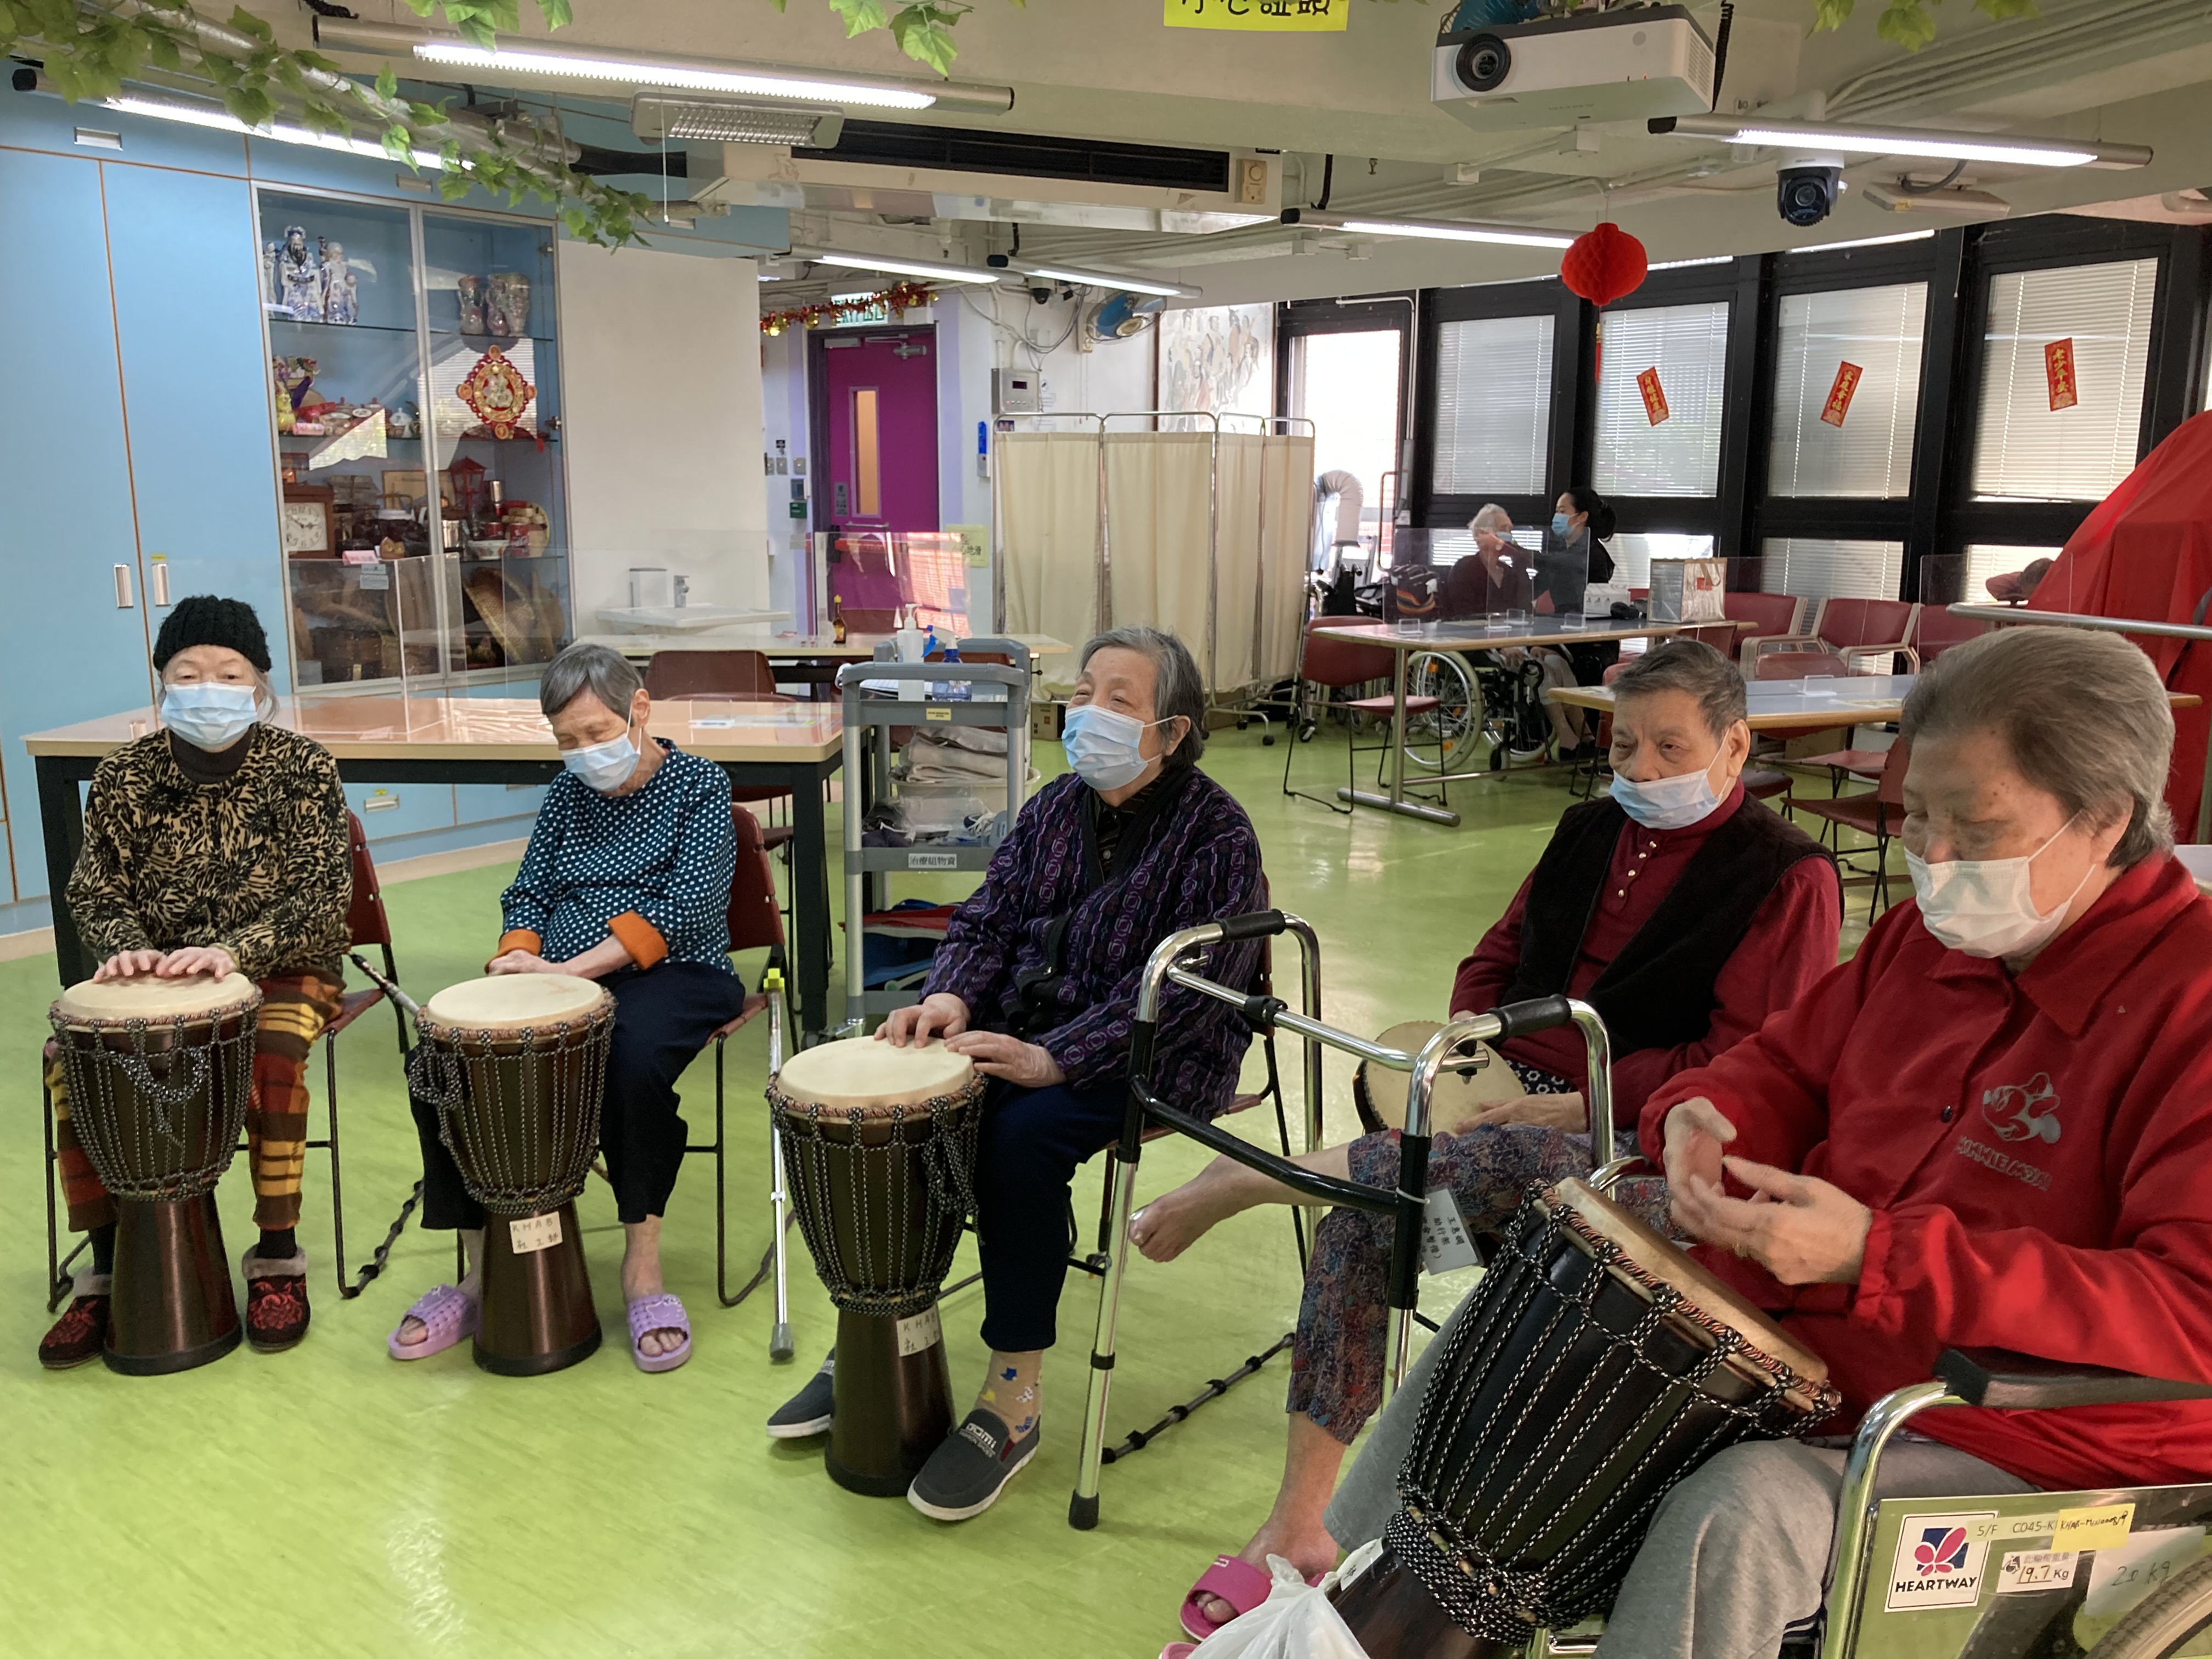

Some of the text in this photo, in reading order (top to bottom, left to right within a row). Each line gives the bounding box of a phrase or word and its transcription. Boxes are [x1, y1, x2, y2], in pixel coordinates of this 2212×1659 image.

[909, 856, 956, 866] 治療組物資
[2019, 1565, 2051, 1583] 19.7
[1895, 1576, 1978, 1593] HEARTWAY
